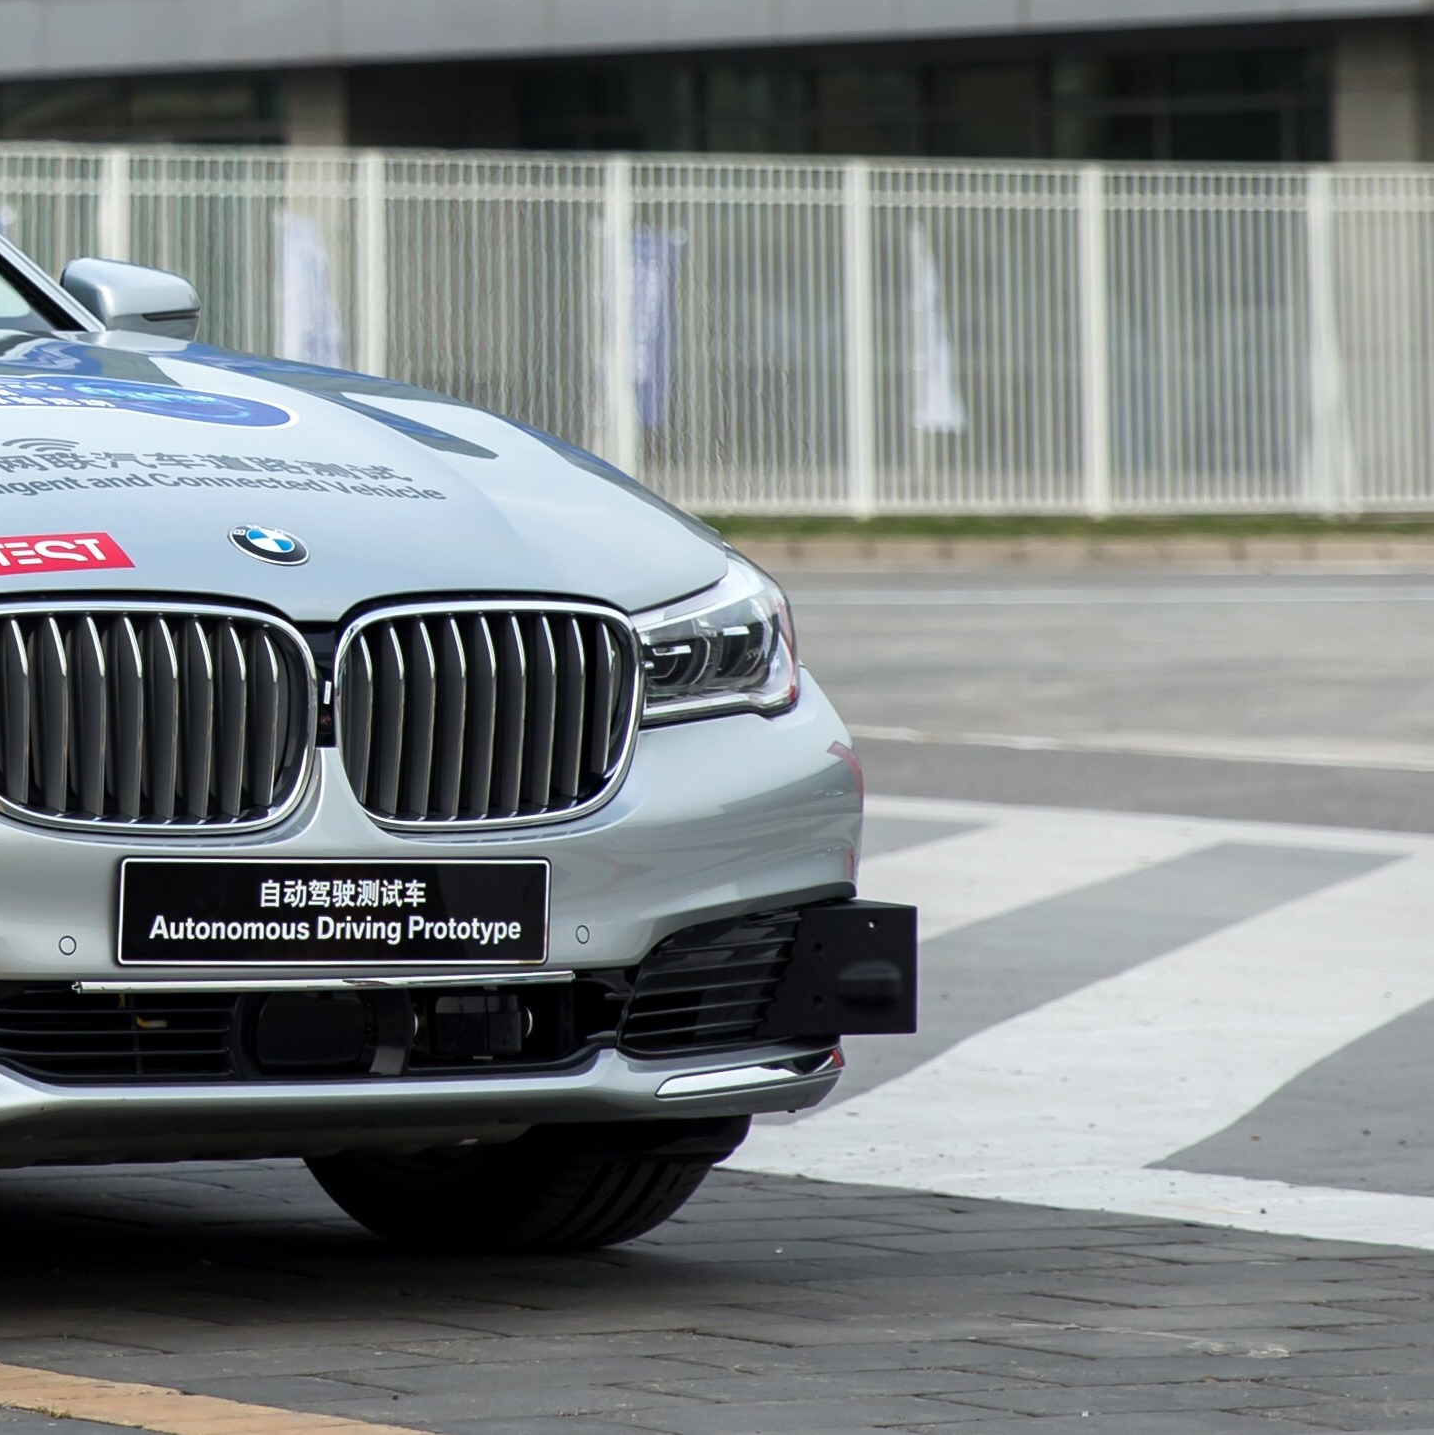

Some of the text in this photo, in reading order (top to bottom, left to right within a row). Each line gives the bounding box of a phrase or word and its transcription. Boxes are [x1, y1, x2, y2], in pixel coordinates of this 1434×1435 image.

[92, 471, 151, 491] and
[149, 472, 337, 495] Connected
[331, 481, 448, 501] Vehicle
[259, 879, 427, 909] 自动驾驶测试车
[149, 915, 523, 945] Autonomous Driving Prototype
